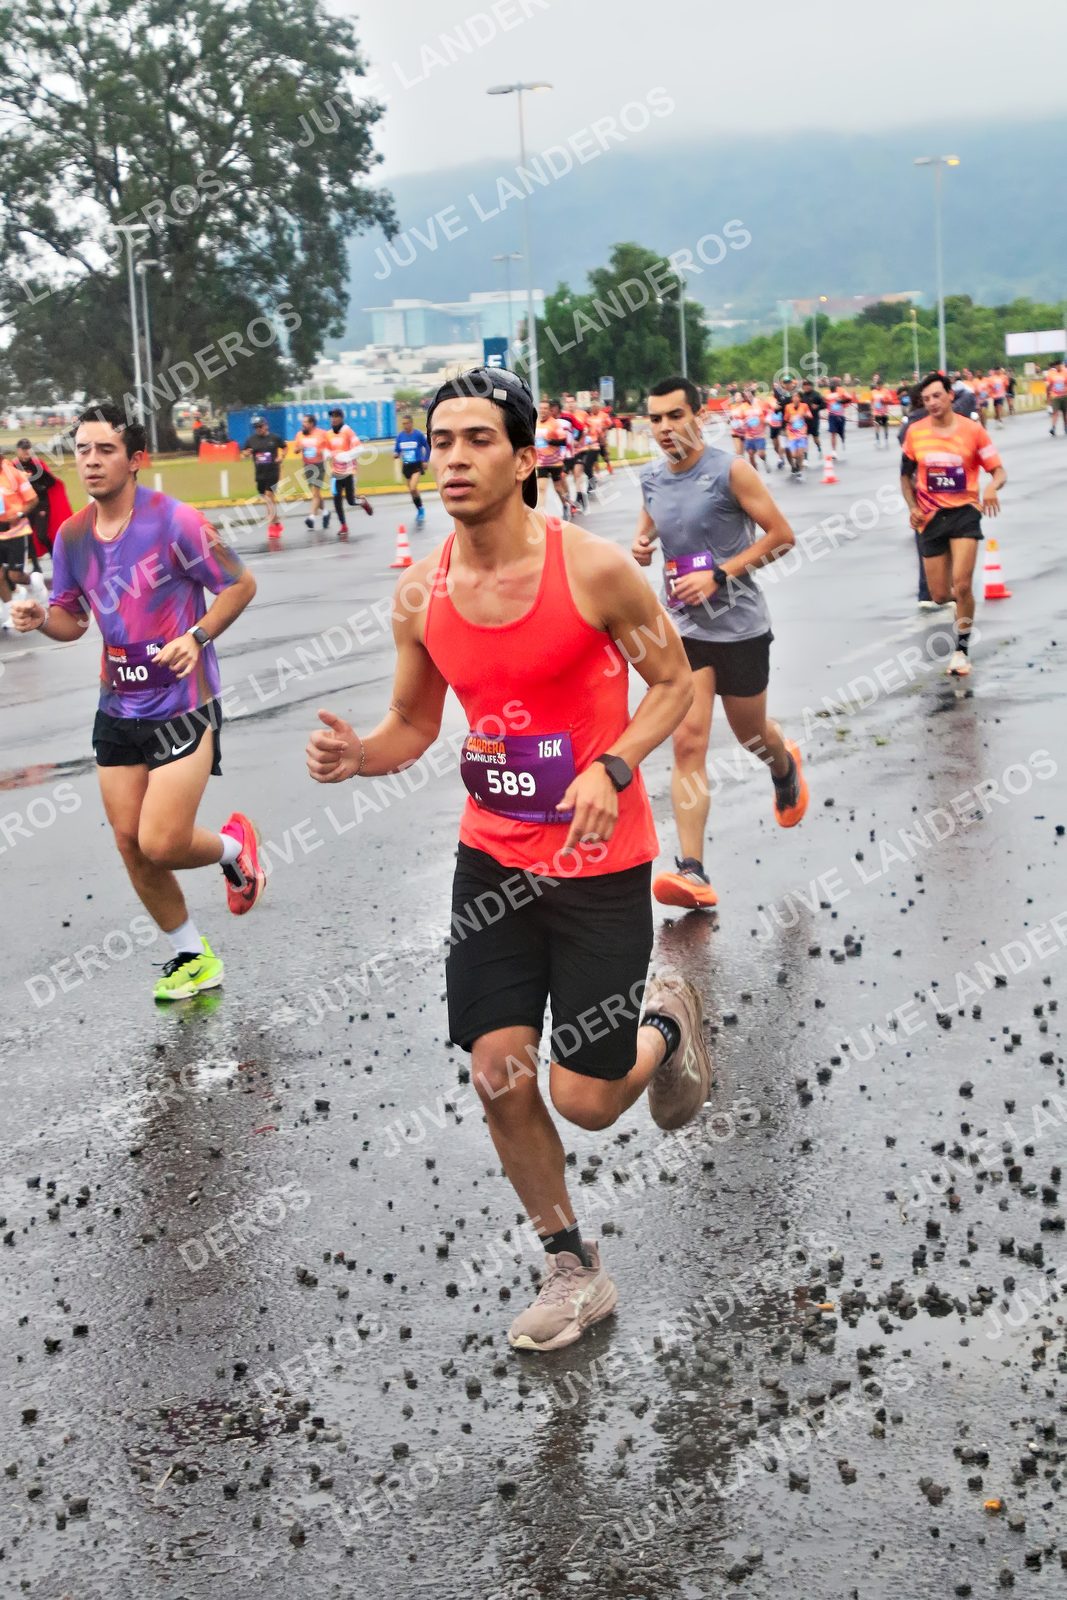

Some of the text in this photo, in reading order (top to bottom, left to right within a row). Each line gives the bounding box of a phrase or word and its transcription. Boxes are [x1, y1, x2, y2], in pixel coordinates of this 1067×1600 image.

[117, 665, 149, 682] 140
[538, 739, 562, 758] 15K
[486, 769, 536, 797] 589
